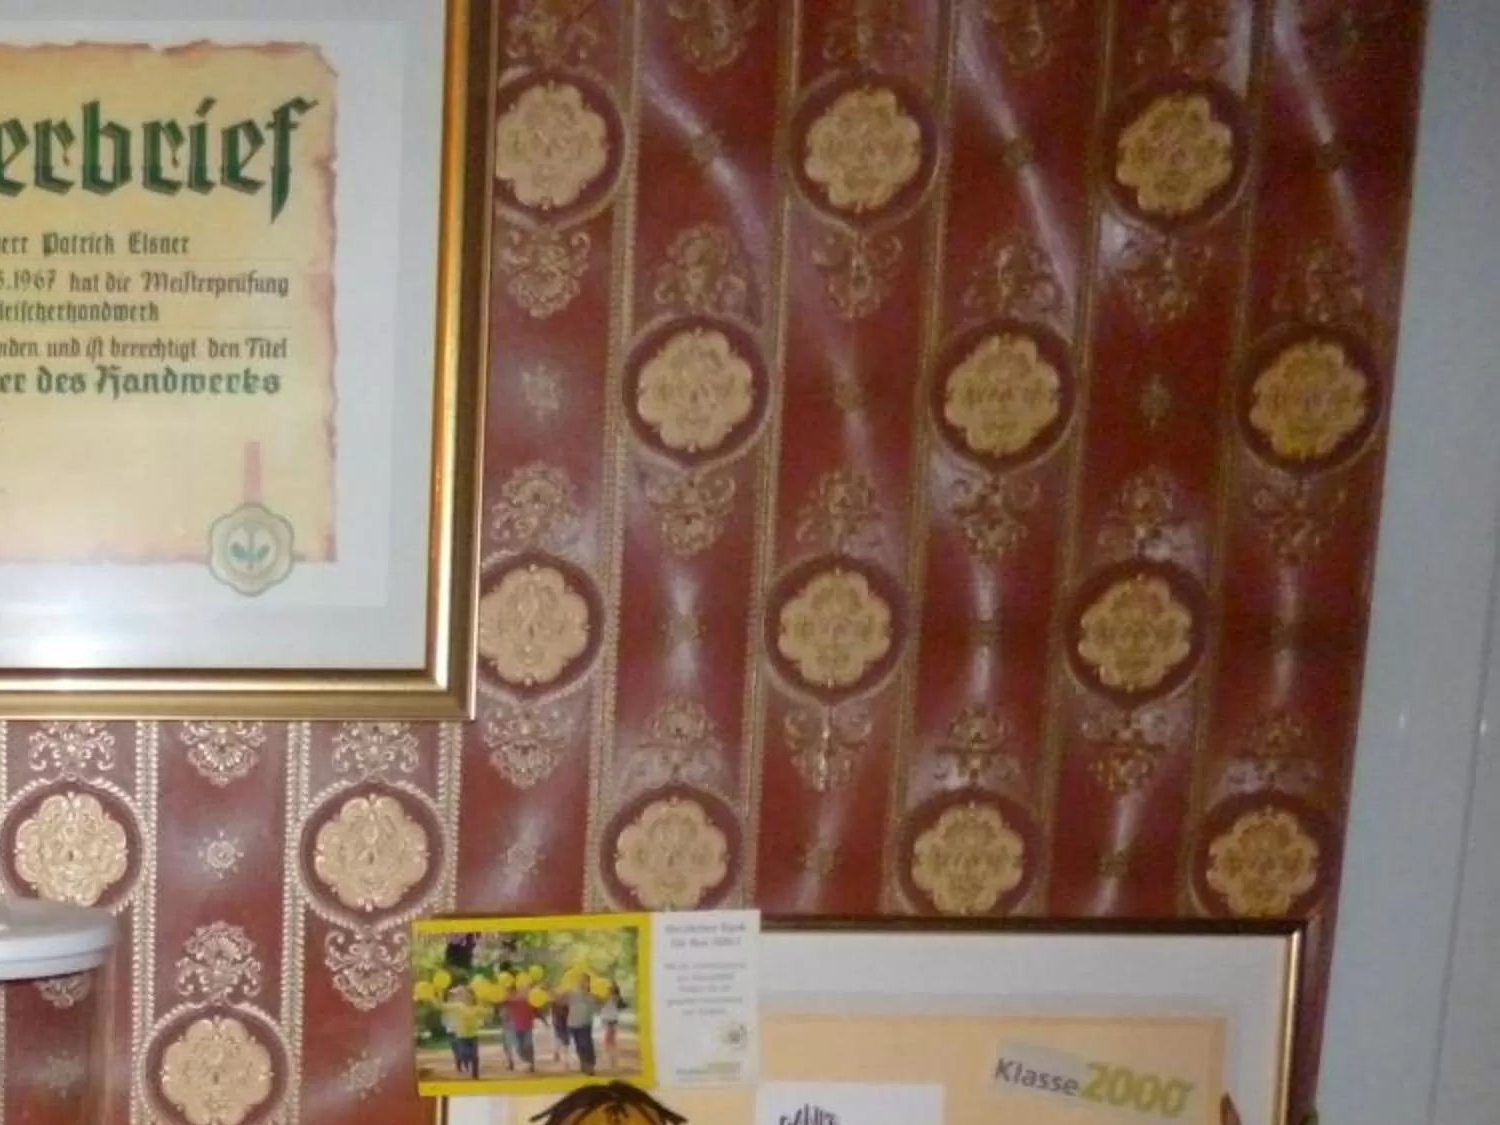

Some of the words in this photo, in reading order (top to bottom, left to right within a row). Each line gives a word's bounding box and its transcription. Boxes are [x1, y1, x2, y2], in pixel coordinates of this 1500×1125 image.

[127, 230, 191, 257] Elsner
[68, 271, 100, 294] hat
[105, 271, 132, 294] die
[47, 336, 81, 359] und
[110, 335, 197, 363] berechtigt
[208, 337, 241, 359] den
[245, 336, 288, 359] Titel
[37, 365, 87, 395] des
[95, 364, 282, 401] Handwerks
